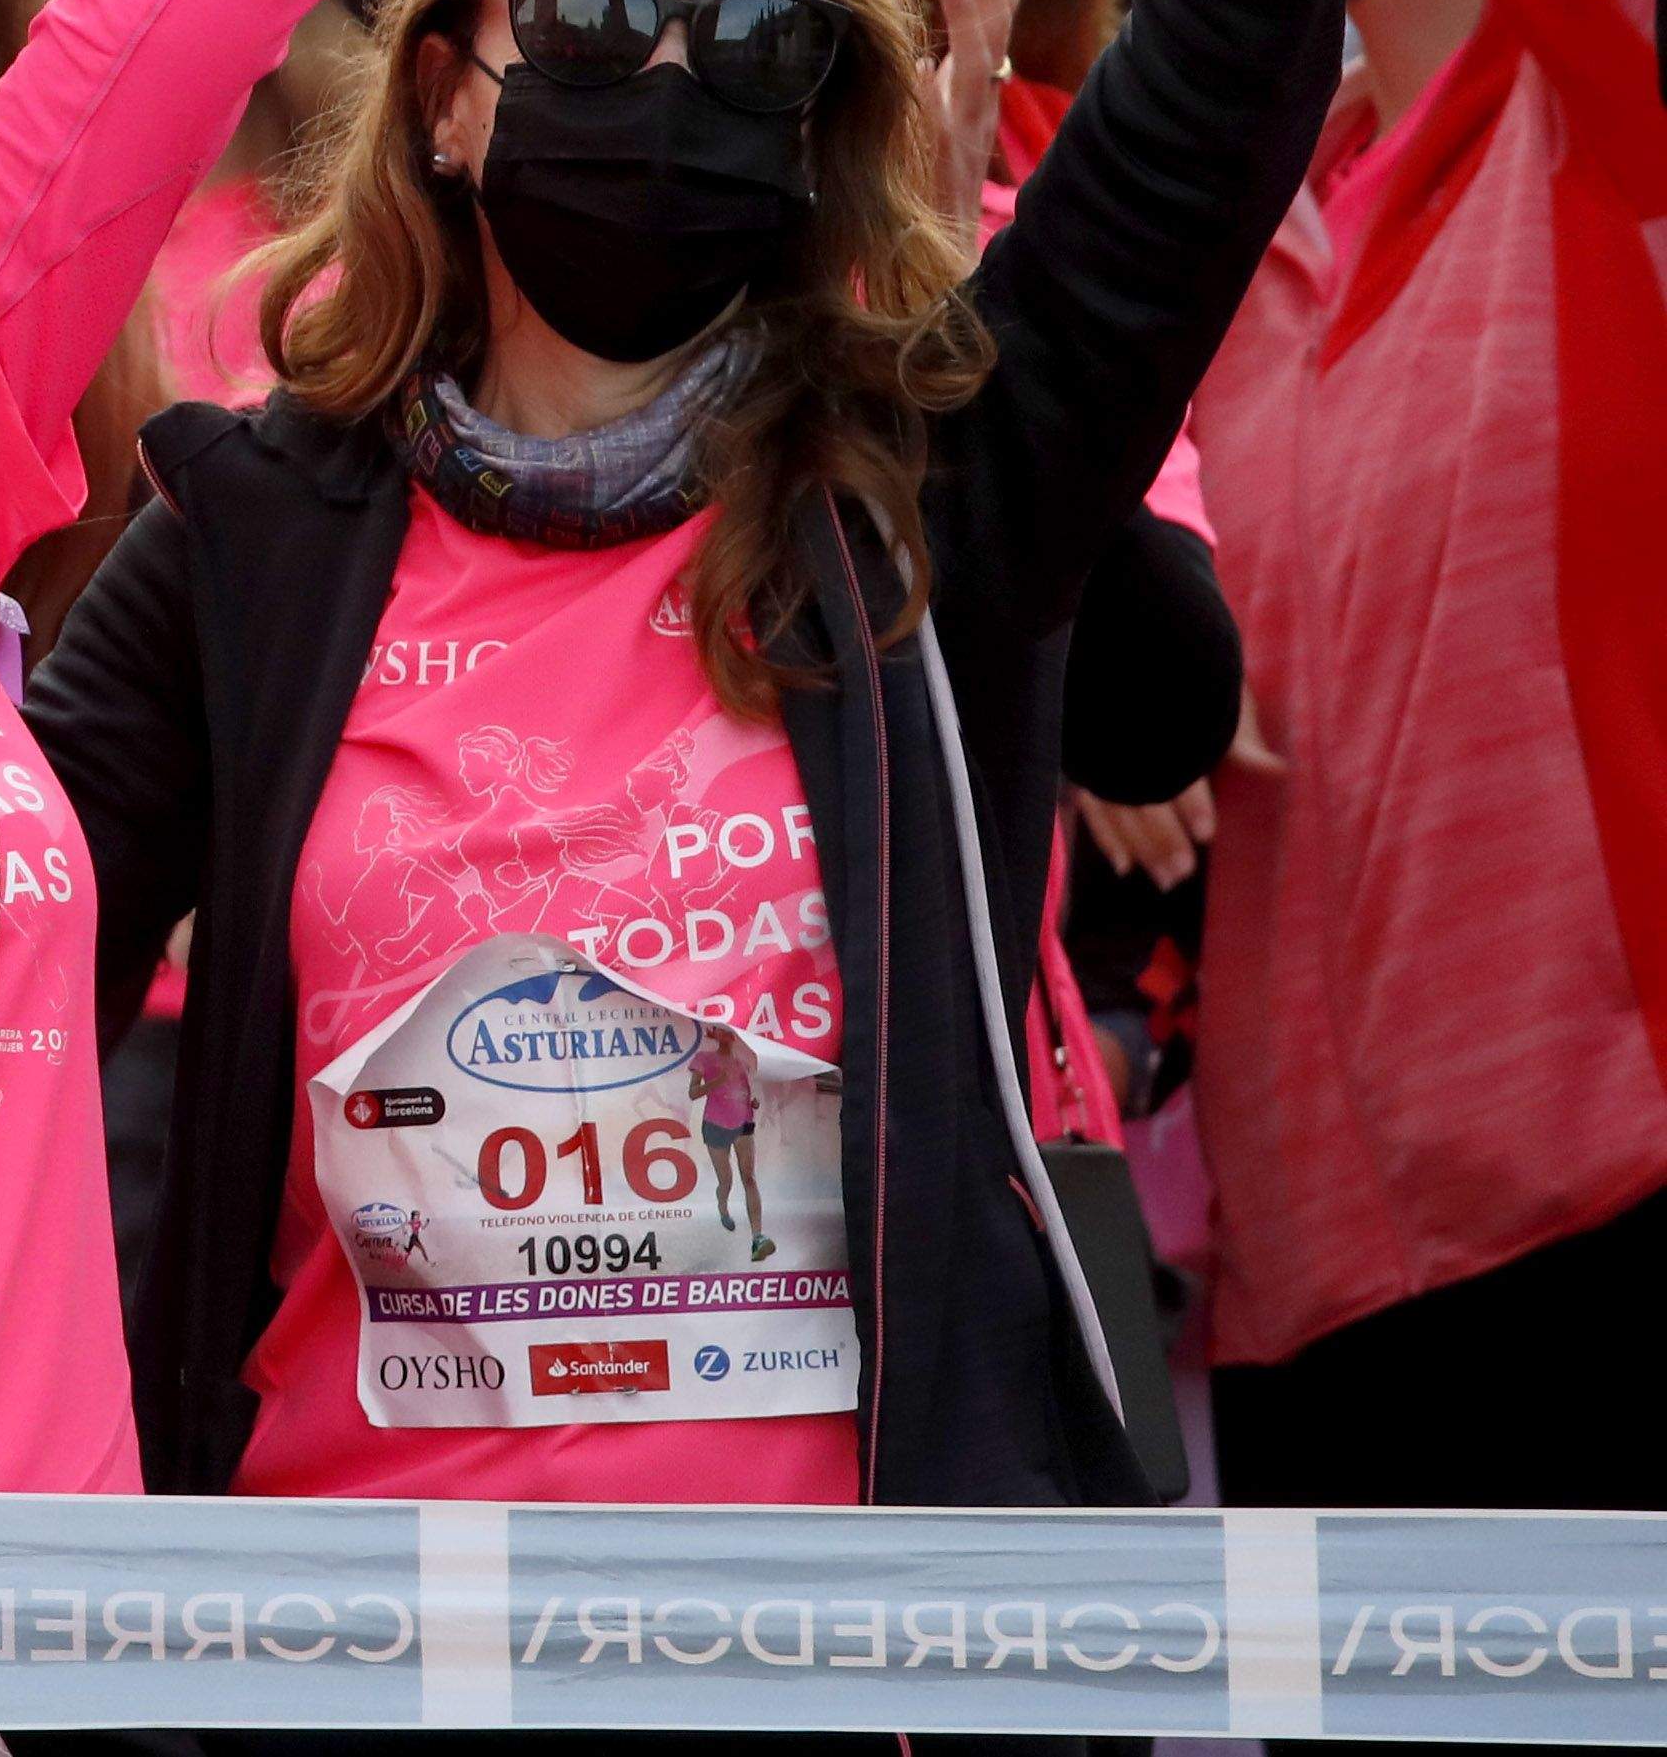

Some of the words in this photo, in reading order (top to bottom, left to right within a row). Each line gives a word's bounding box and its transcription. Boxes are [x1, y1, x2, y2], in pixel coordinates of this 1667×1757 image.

[503, 1010, 579, 1027] CENTRAL
[587, 1006, 671, 1023] LECHERA
[30, 1028, 68, 1052] 20
[467, 1018, 684, 1066] ASTURIANA
[385, 1105, 435, 1118] Barcelona
[477, 1117, 699, 1211] 016
[479, 1215, 546, 1229] TELÉFONO
[548, 1212, 615, 1225] VIOLENCIA
[618, 1210, 637, 1223] DE
[518, 1230, 663, 1276] 10994
[377, 1291, 440, 1317] CURSA
[441, 1291, 474, 1317] DE
[478, 1285, 531, 1316] LES
[537, 1280, 634, 1312] DONES
[641, 1280, 682, 1308] DE
[687, 1275, 851, 1306] BARCELONA
[569, 1358, 651, 1378] Santander
[743, 1348, 840, 1372] ZURICH
[379, 1354, 506, 1391] OYSHO
